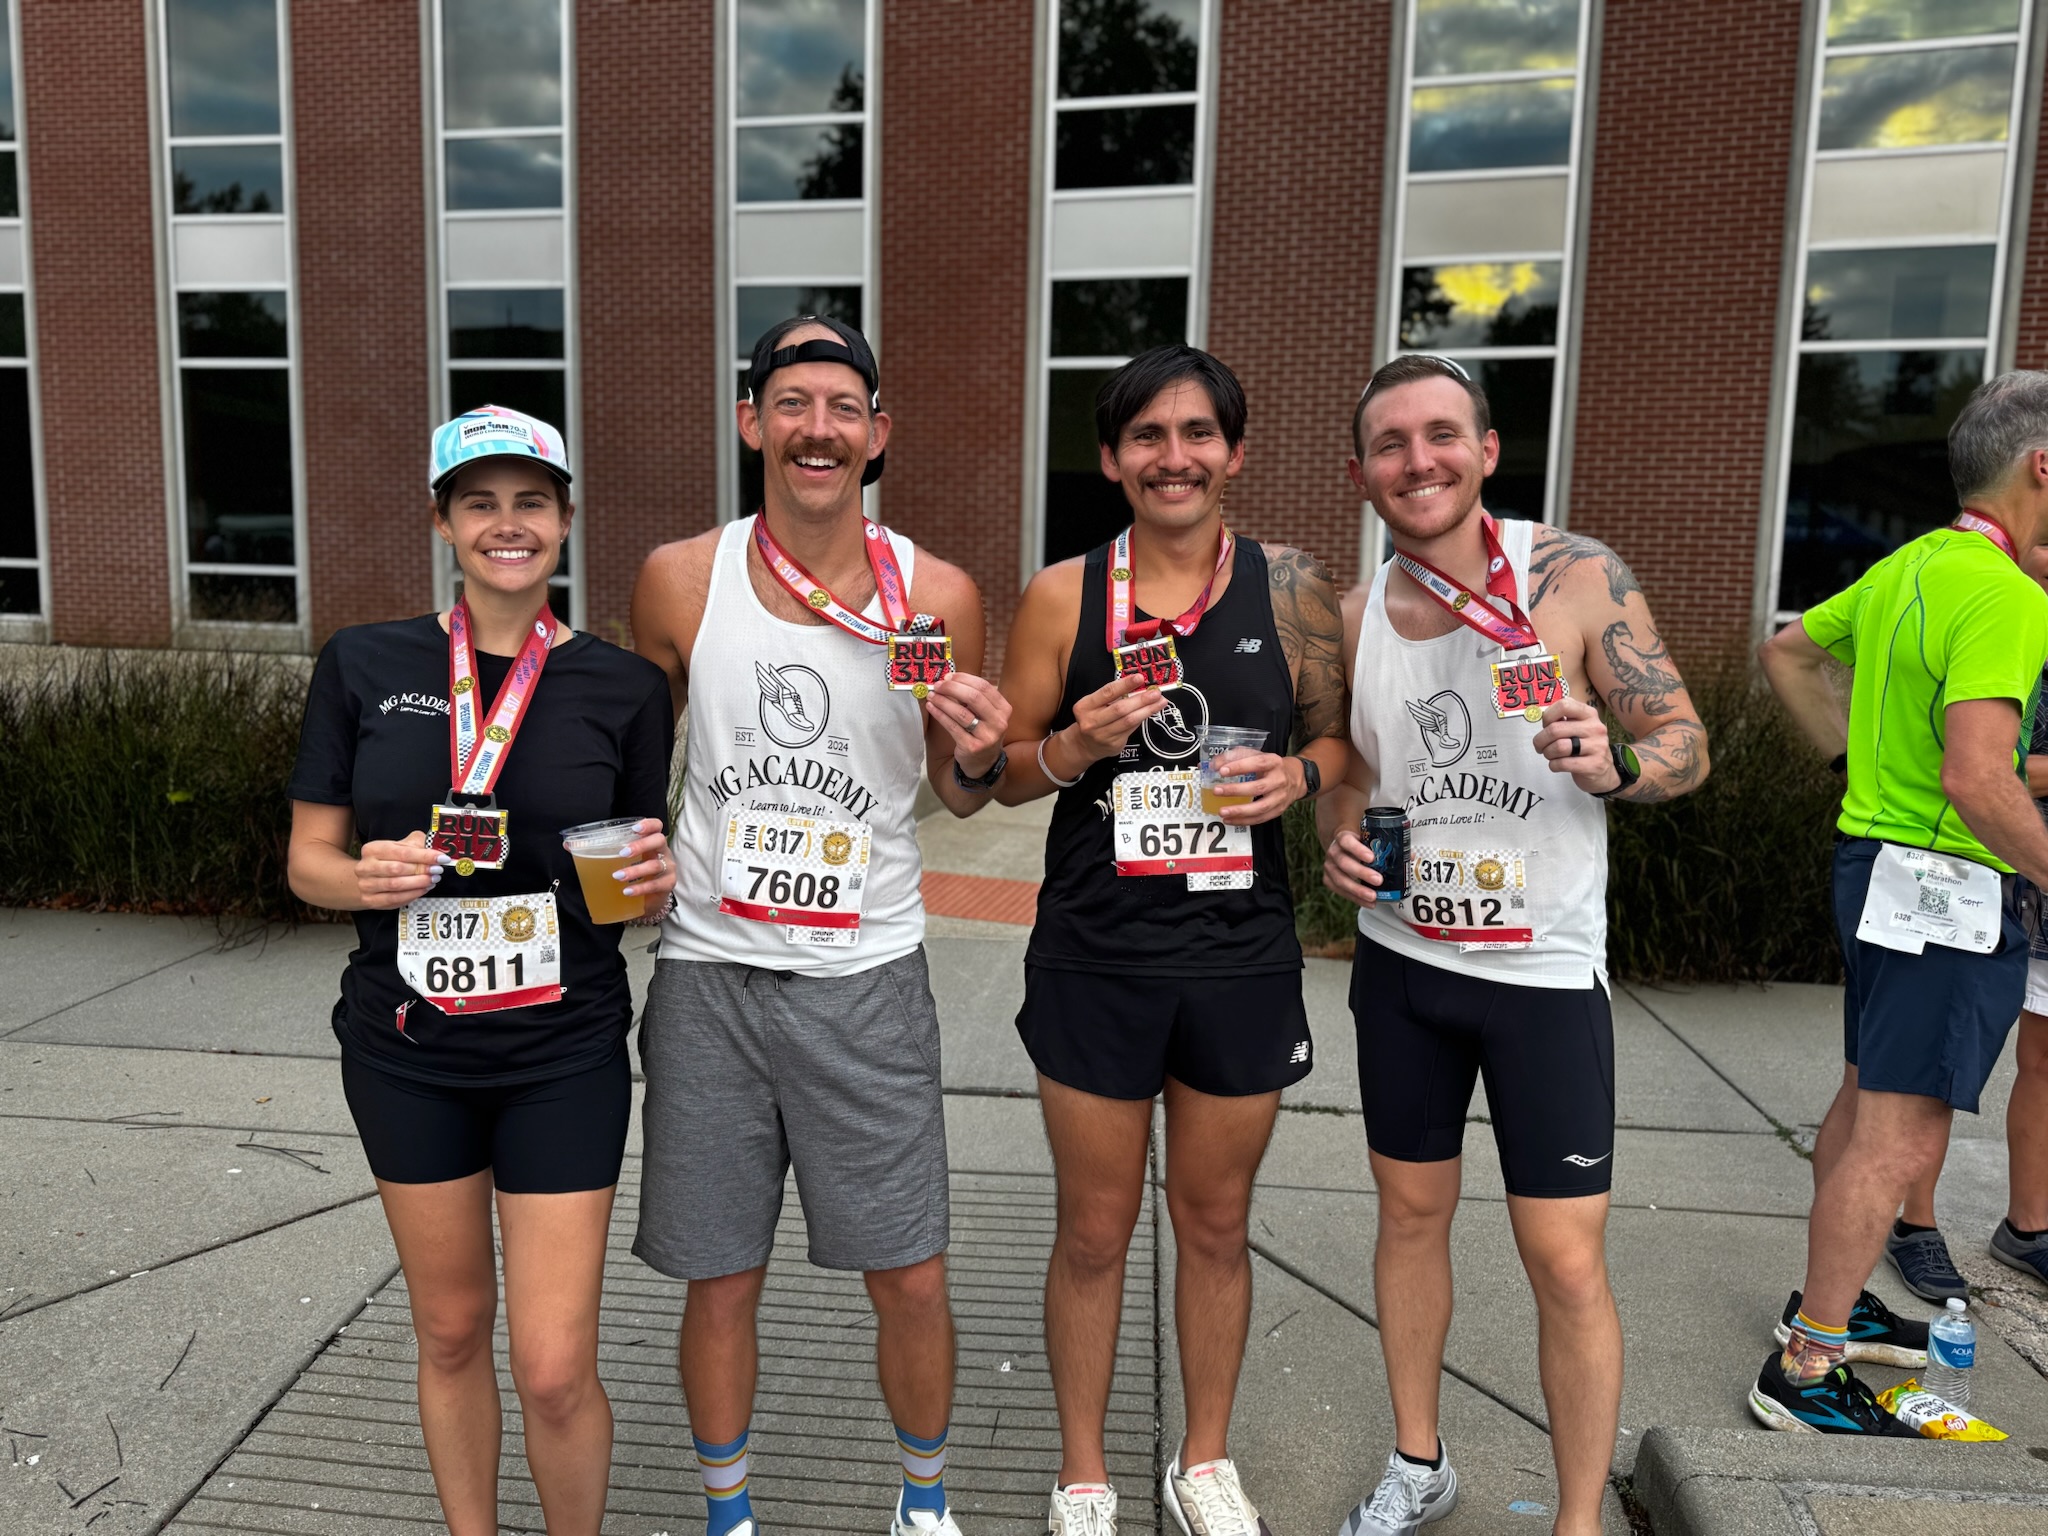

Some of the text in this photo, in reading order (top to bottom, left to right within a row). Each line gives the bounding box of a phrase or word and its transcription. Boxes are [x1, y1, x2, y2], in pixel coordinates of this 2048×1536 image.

[779, 564, 801, 582] 317
[885, 577, 898, 593] LOVE
[1430, 577, 1451, 597] SPEEDWAY
[1115, 602, 1128, 618] 317
[1471, 608, 1489, 622] 317
[836, 611, 870, 632] SPEEDWAY
[455, 650, 467, 665] 317
[895, 643, 945, 660] RUN
[1120, 644, 1170, 669] RUN
[516, 673, 524, 685] LIVE
[523, 665, 531, 680] LOVE
[895, 660, 946, 683] 317
[1123, 659, 1172, 686] 17
[1499, 662, 1554, 687] RUN
[503, 693, 521, 712] 317
[1502, 680, 1557, 708] 317
[379, 693, 450, 715] MG ACADEM
[460, 702, 471, 732] SPEEDWAY
[735, 731, 755, 742] EST.
[827, 740, 849, 752] 2024
[1120, 748, 1139, 759] EST.
[1476, 749, 1498, 760] 2024
[472, 750, 495, 781] SPEEDWAY
[1409, 763, 1428, 774] EST.
[707, 755, 879, 822] MG ACADEMY
[1130, 786, 1142, 810] RUN
[750, 800, 779, 811] Learn
[780, 802, 790, 812] to
[812, 805, 825, 816] It!
[439, 814, 500, 835] RUN
[1411, 813, 1486, 828] Learn to Love It!
[743, 825, 757, 849] RUN
[1121, 833, 1131, 844] B
[1140, 821, 1228, 857] 6572
[438, 834, 499, 860] 317
[1440, 850, 1454, 858] LOVE
[747, 866, 840, 909] 7608
[1927, 872, 1962, 886] Marathon
[1412, 895, 1504, 926] 6812
[417, 913, 429, 939] RUN
[409, 971, 417, 982] A
[426, 953, 523, 993] 6811
[1909, 1398, 1946, 1415] Cooked
[1923, 1405, 1955, 1417] Kettle
